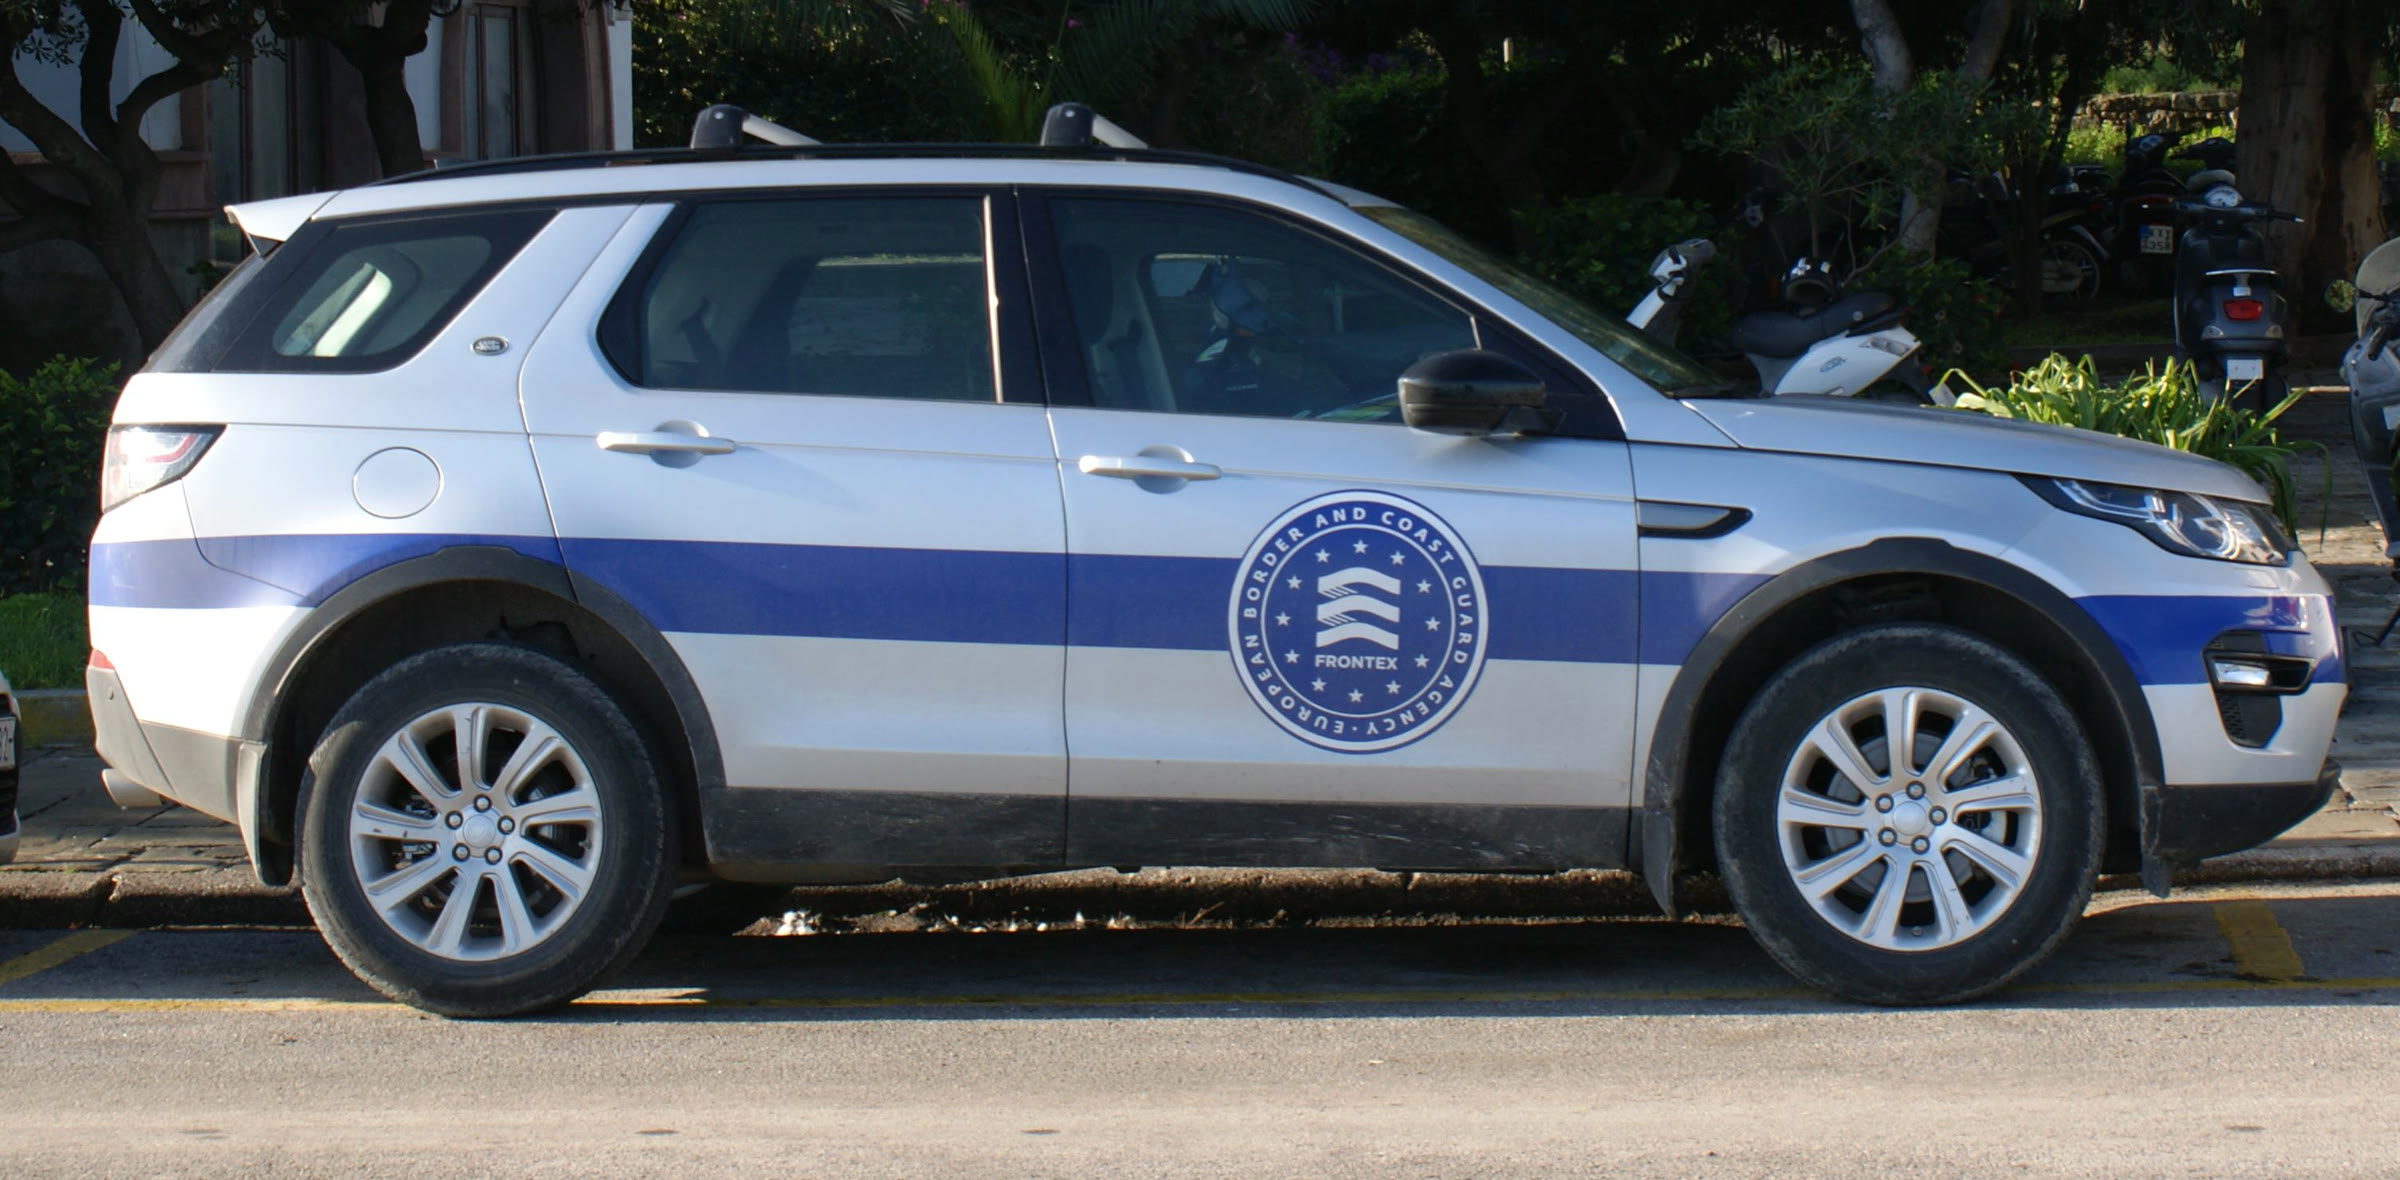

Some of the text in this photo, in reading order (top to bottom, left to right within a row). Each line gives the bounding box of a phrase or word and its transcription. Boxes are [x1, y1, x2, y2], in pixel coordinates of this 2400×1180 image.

[1243, 506, 1473, 736] EUROPEAN BORDER AND COAST GUARD AGENCY
[1314, 653, 1399, 671] FRONTEX
